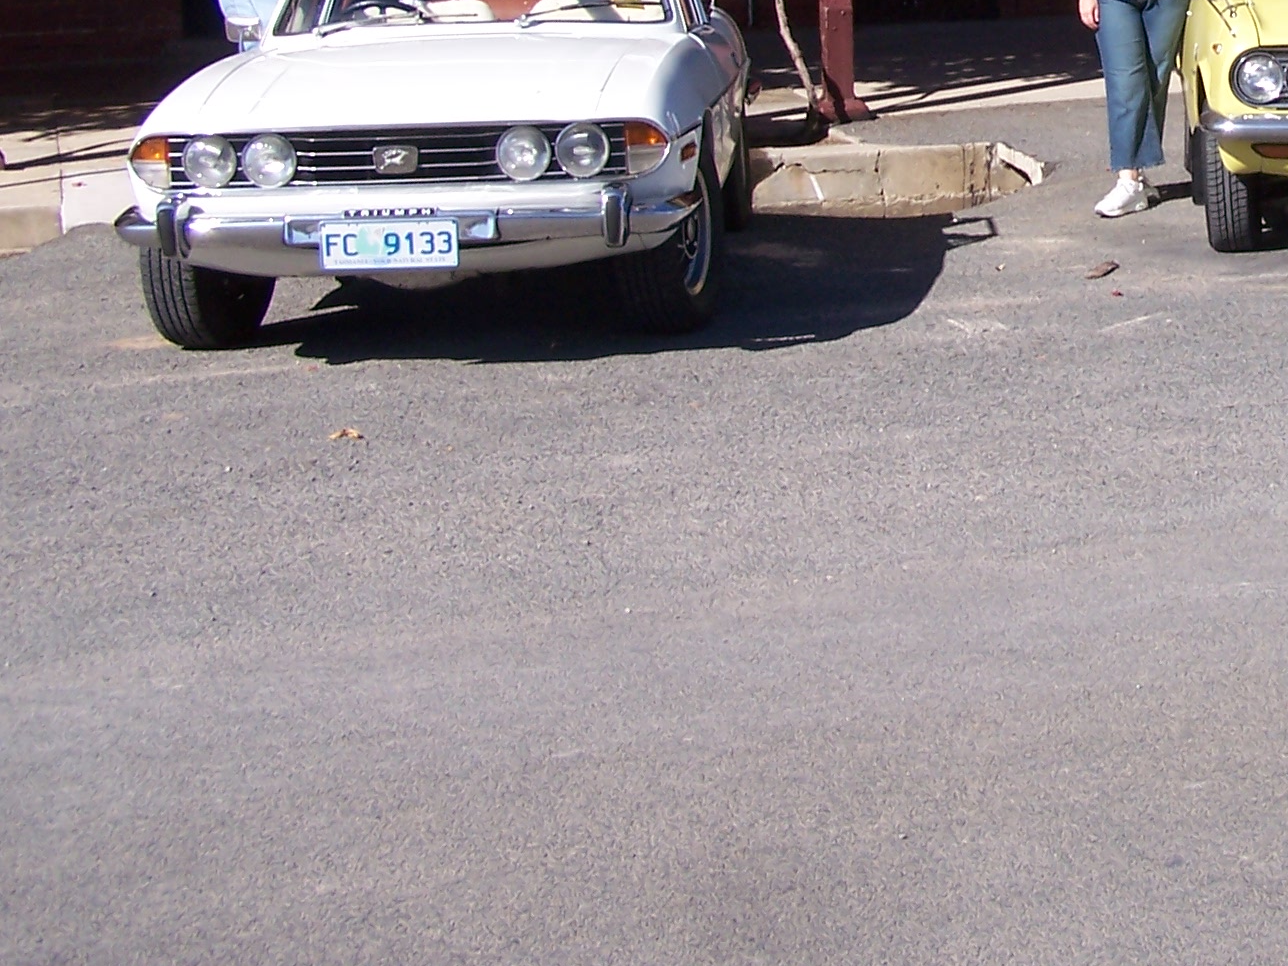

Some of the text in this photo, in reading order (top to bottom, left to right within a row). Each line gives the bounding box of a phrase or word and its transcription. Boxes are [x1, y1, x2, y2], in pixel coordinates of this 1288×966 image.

[348, 207, 431, 217] TRIUMPH
[326, 231, 452, 256] FC 9133
